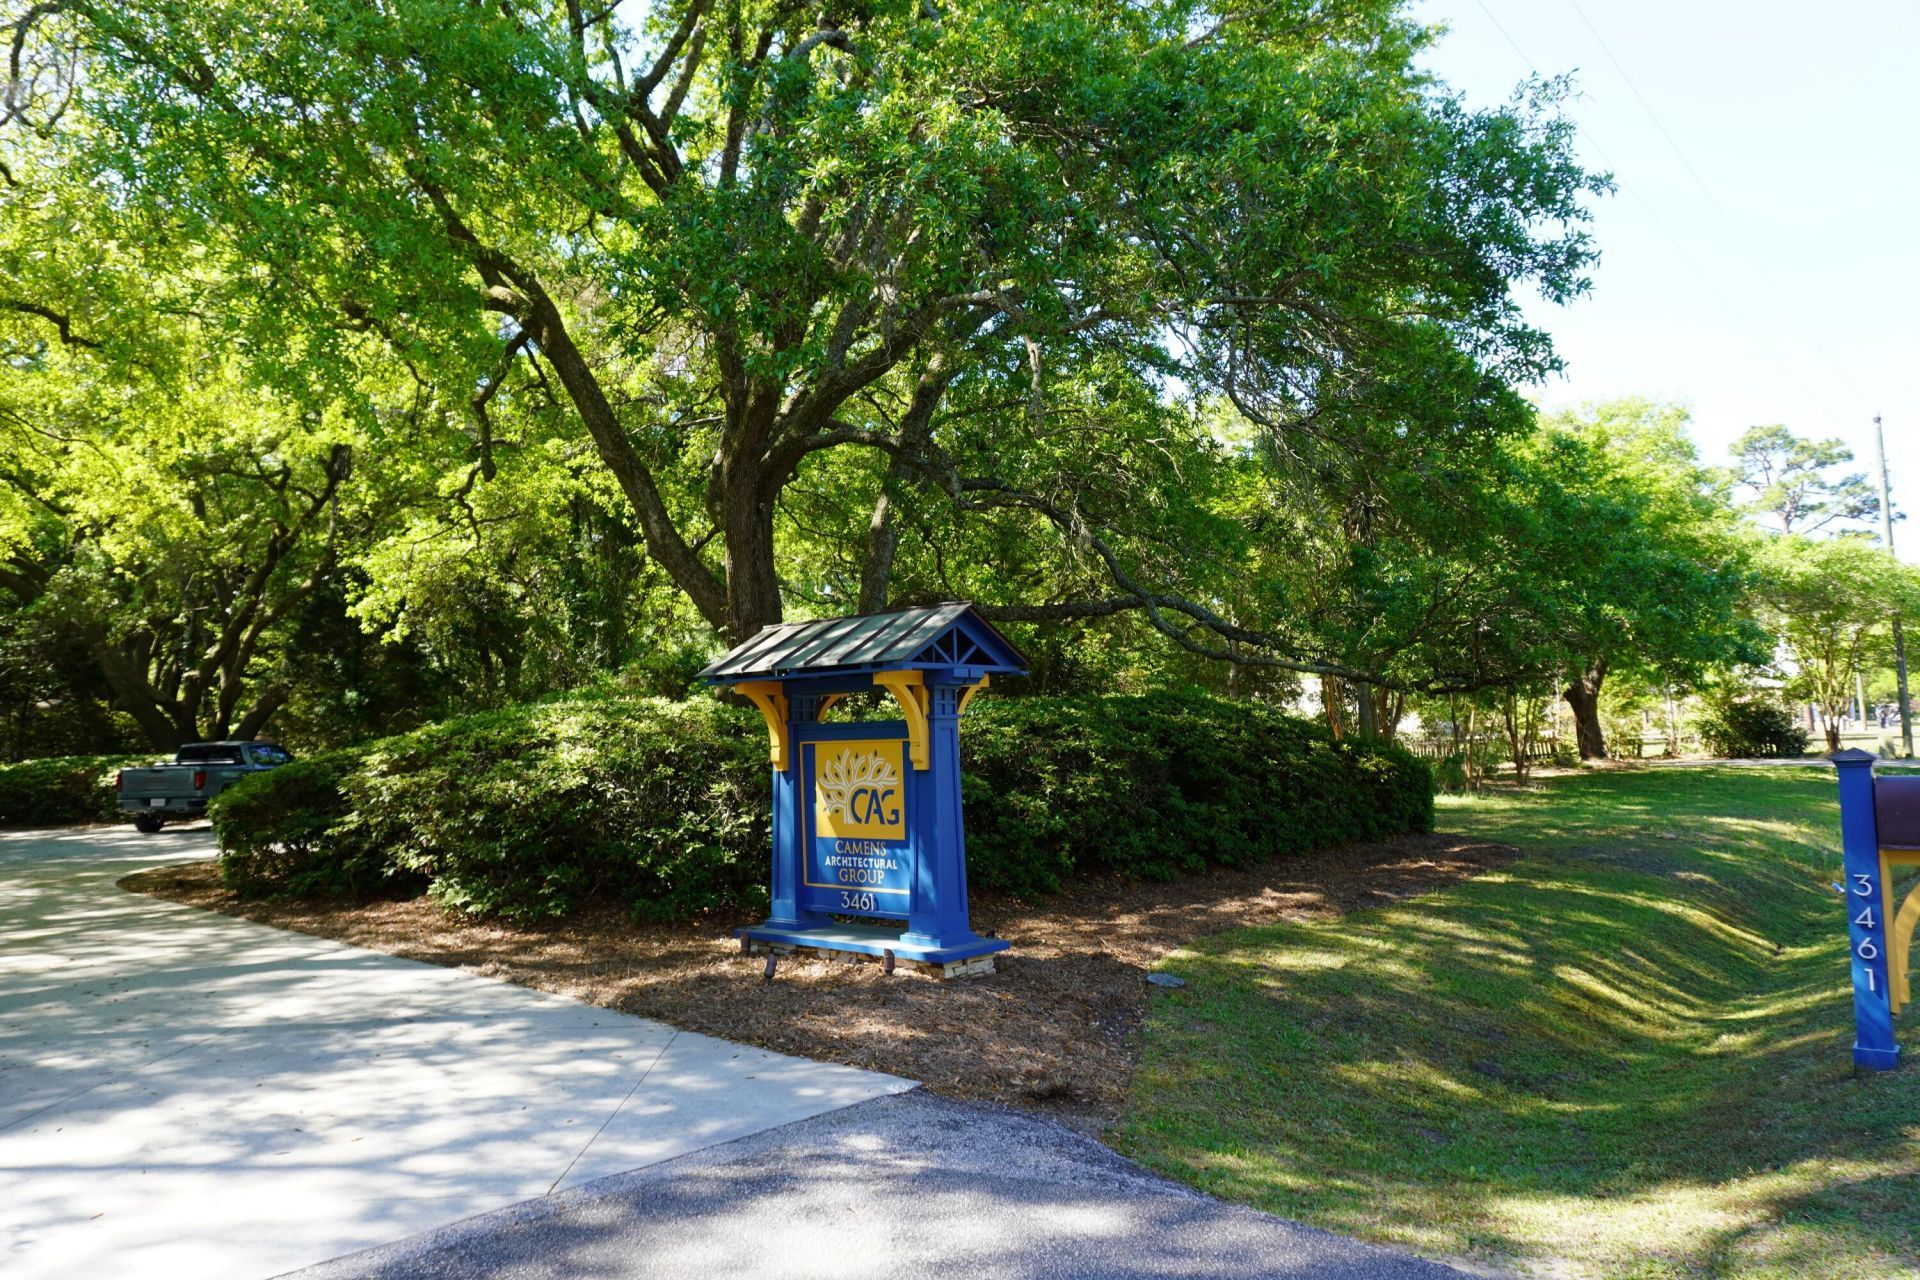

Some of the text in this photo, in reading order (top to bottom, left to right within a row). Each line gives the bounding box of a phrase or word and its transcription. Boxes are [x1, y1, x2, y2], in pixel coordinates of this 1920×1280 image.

[850, 788, 900, 825] CAG
[835, 840, 887, 857] CAMENS
[825, 856, 897, 870] ARCHITECTURAL
[838, 868, 885, 884] GROUP
[841, 891, 875, 911] 3461
